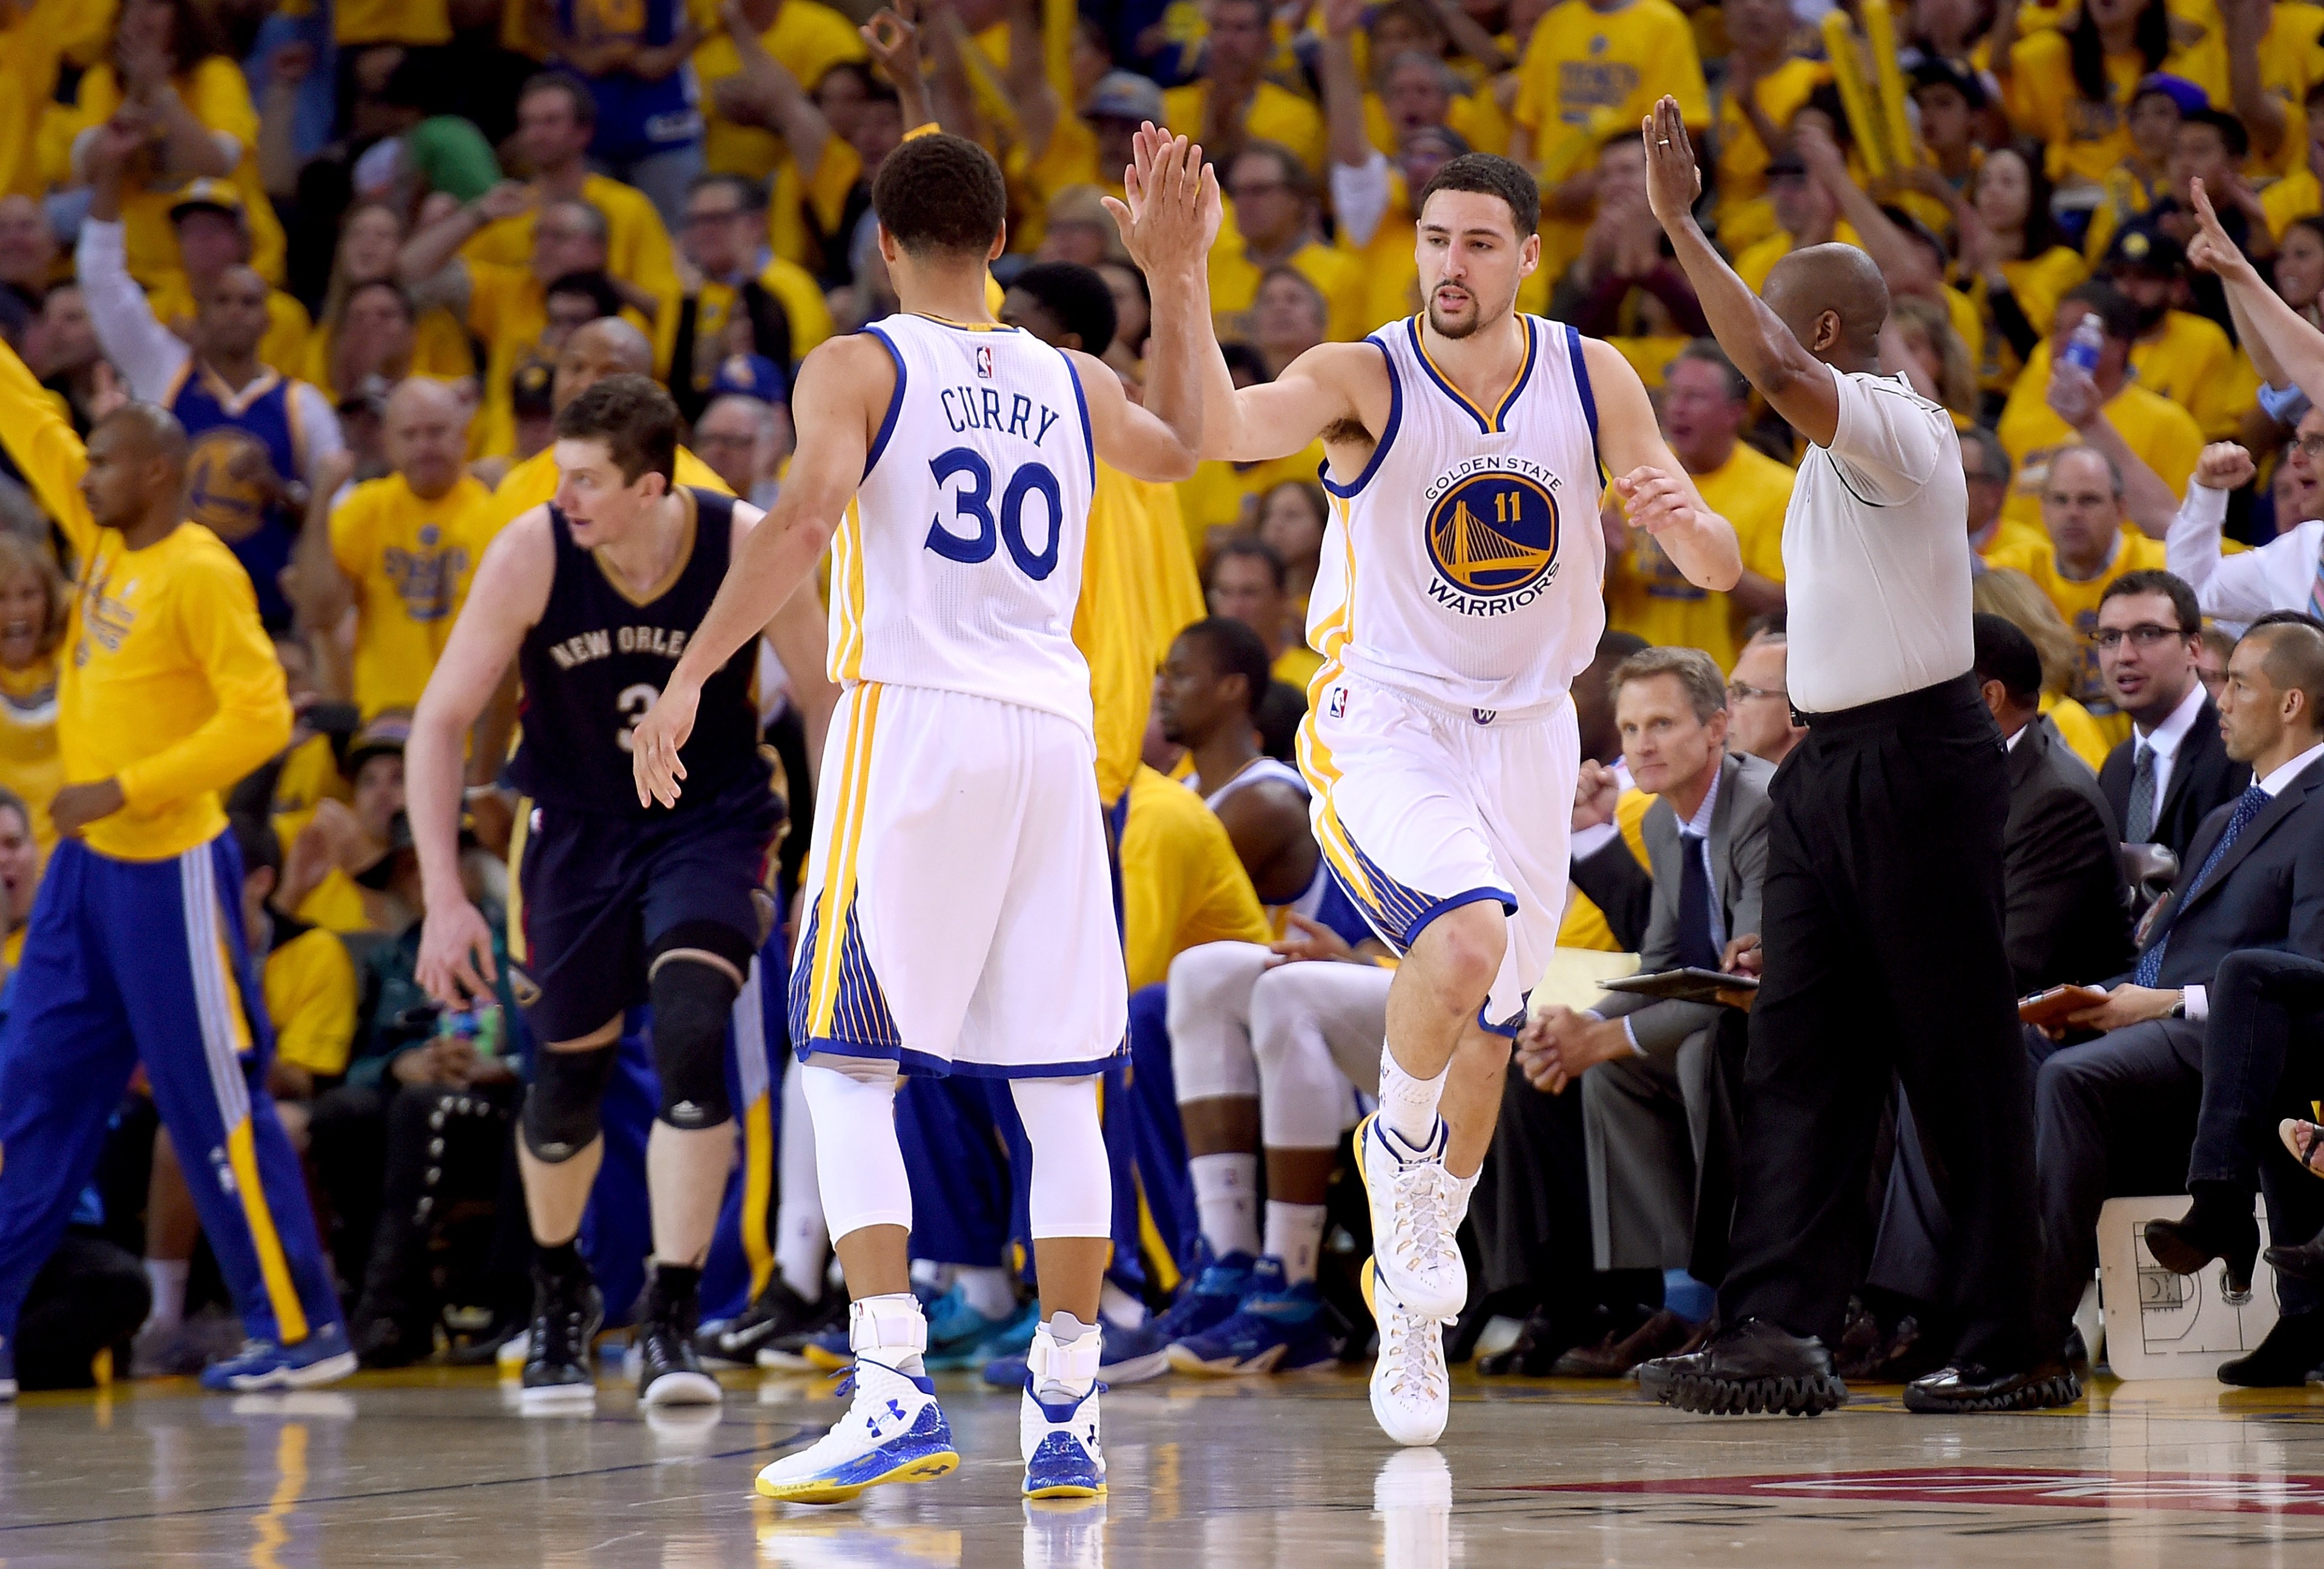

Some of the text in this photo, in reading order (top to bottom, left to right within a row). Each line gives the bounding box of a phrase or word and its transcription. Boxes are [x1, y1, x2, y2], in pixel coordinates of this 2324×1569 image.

[941, 386, 1059, 447] CURRY
[1425, 457, 1562, 500] GOLDEN STATE
[923, 446, 1063, 581] 30
[1494, 491, 1521, 522] 11
[1427, 562, 1560, 616] WARRIORS
[549, 625, 693, 669] NEW ORLE
[1478, 708, 1495, 720] W
